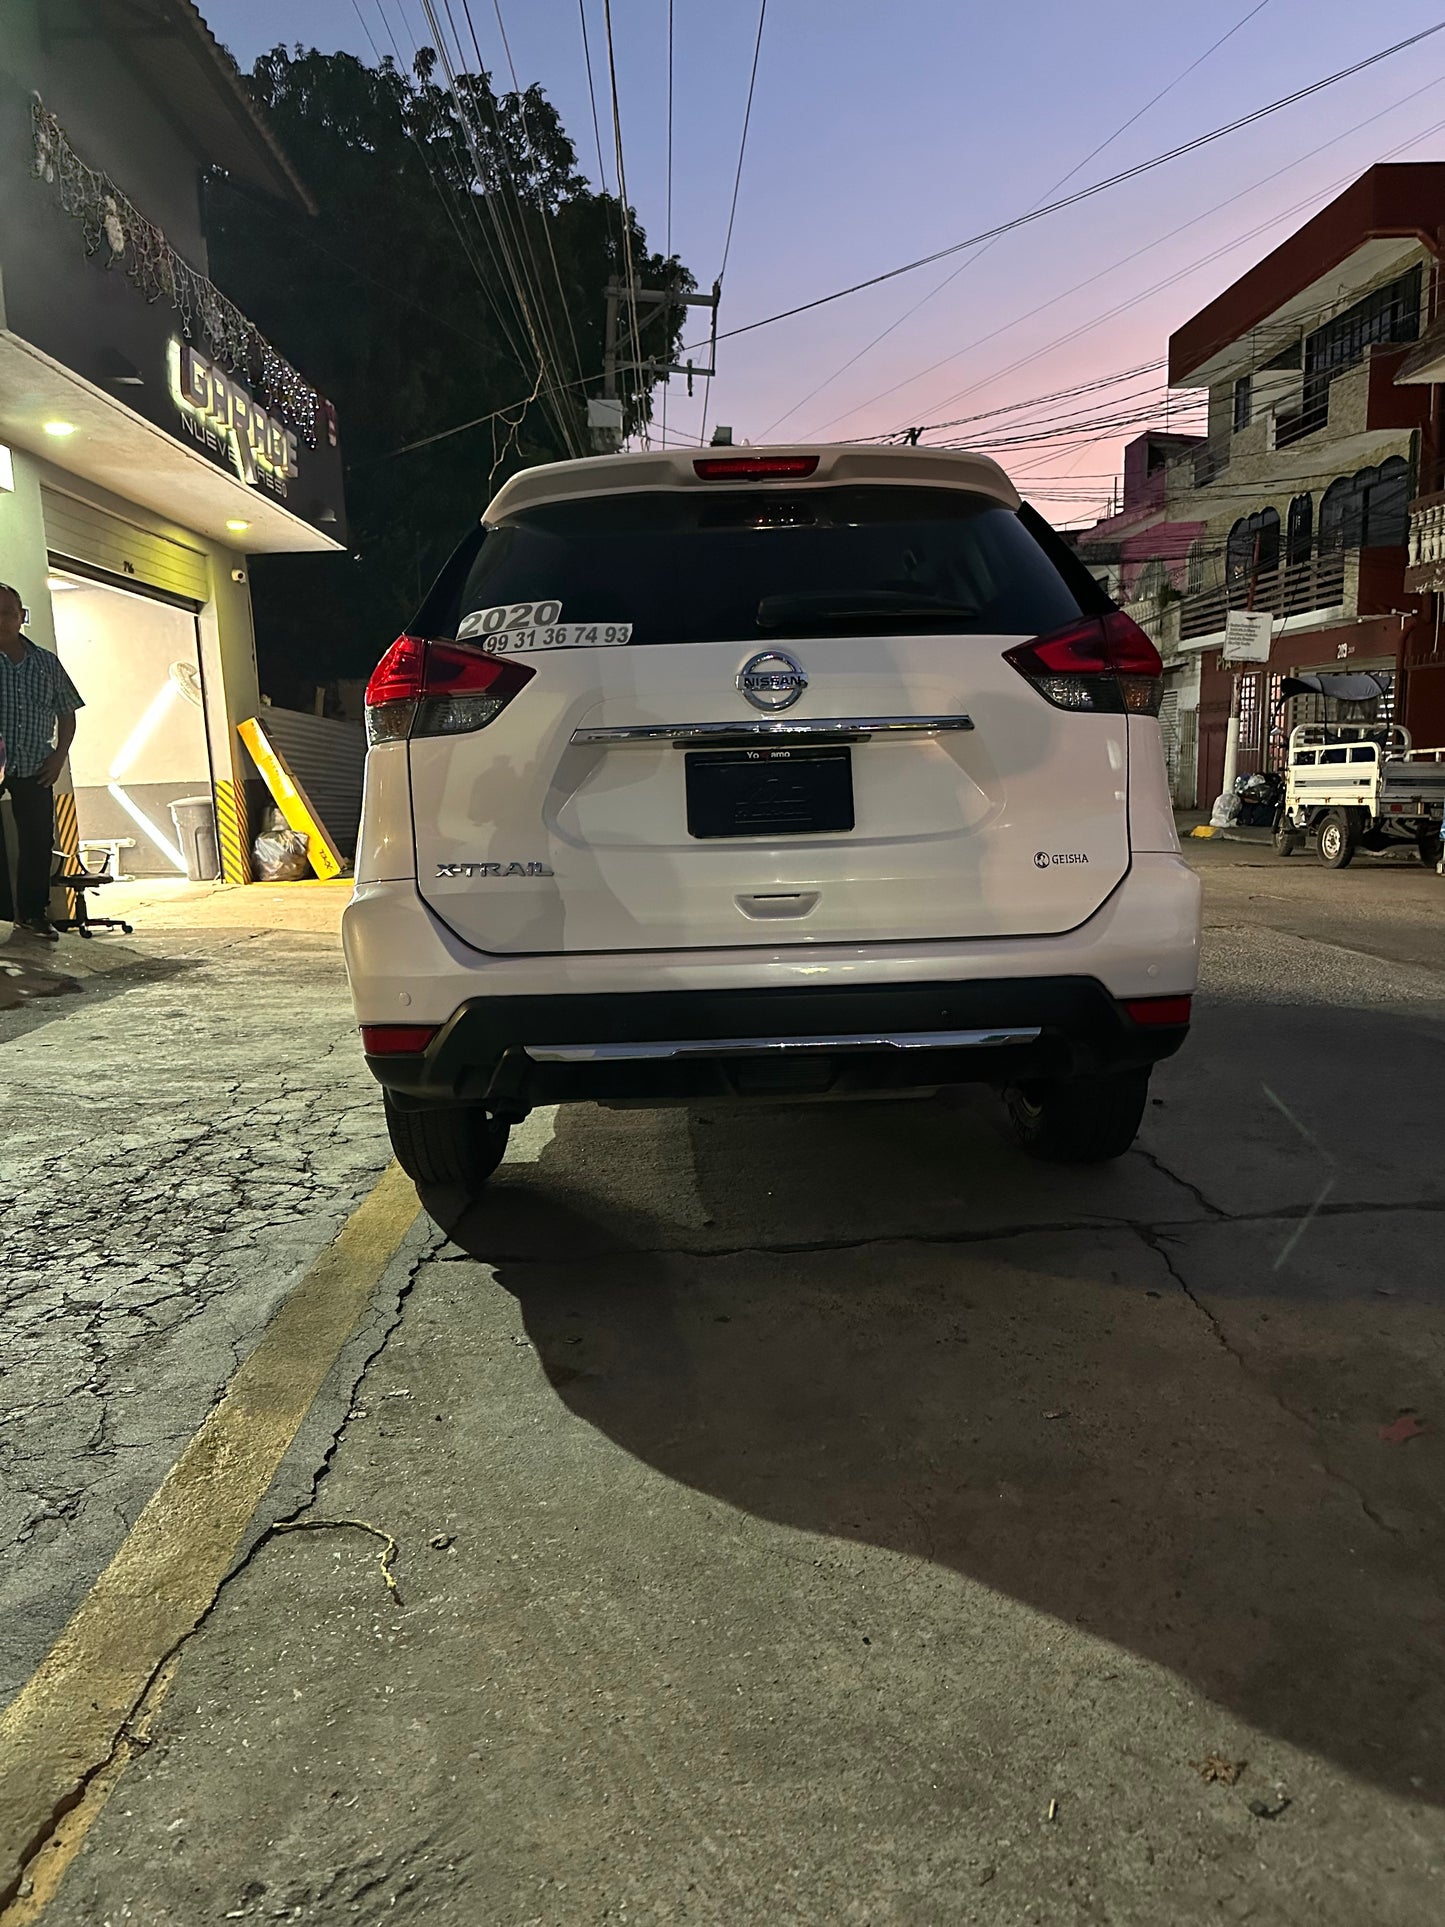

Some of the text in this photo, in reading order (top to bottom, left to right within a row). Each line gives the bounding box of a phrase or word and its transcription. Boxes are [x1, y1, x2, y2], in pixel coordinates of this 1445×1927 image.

[181, 346, 298, 484] GARAGE
[181, 412, 238, 465] NUEVE
[457, 602, 560, 639] 2020
[486, 626, 629, 652] 99 31 36 74 93
[744, 675, 802, 687] NISSAN
[747, 750, 791, 759] Yo amo
[1051, 854, 1089, 864] GEISHA
[435, 862, 555, 877] X-TRAIL
